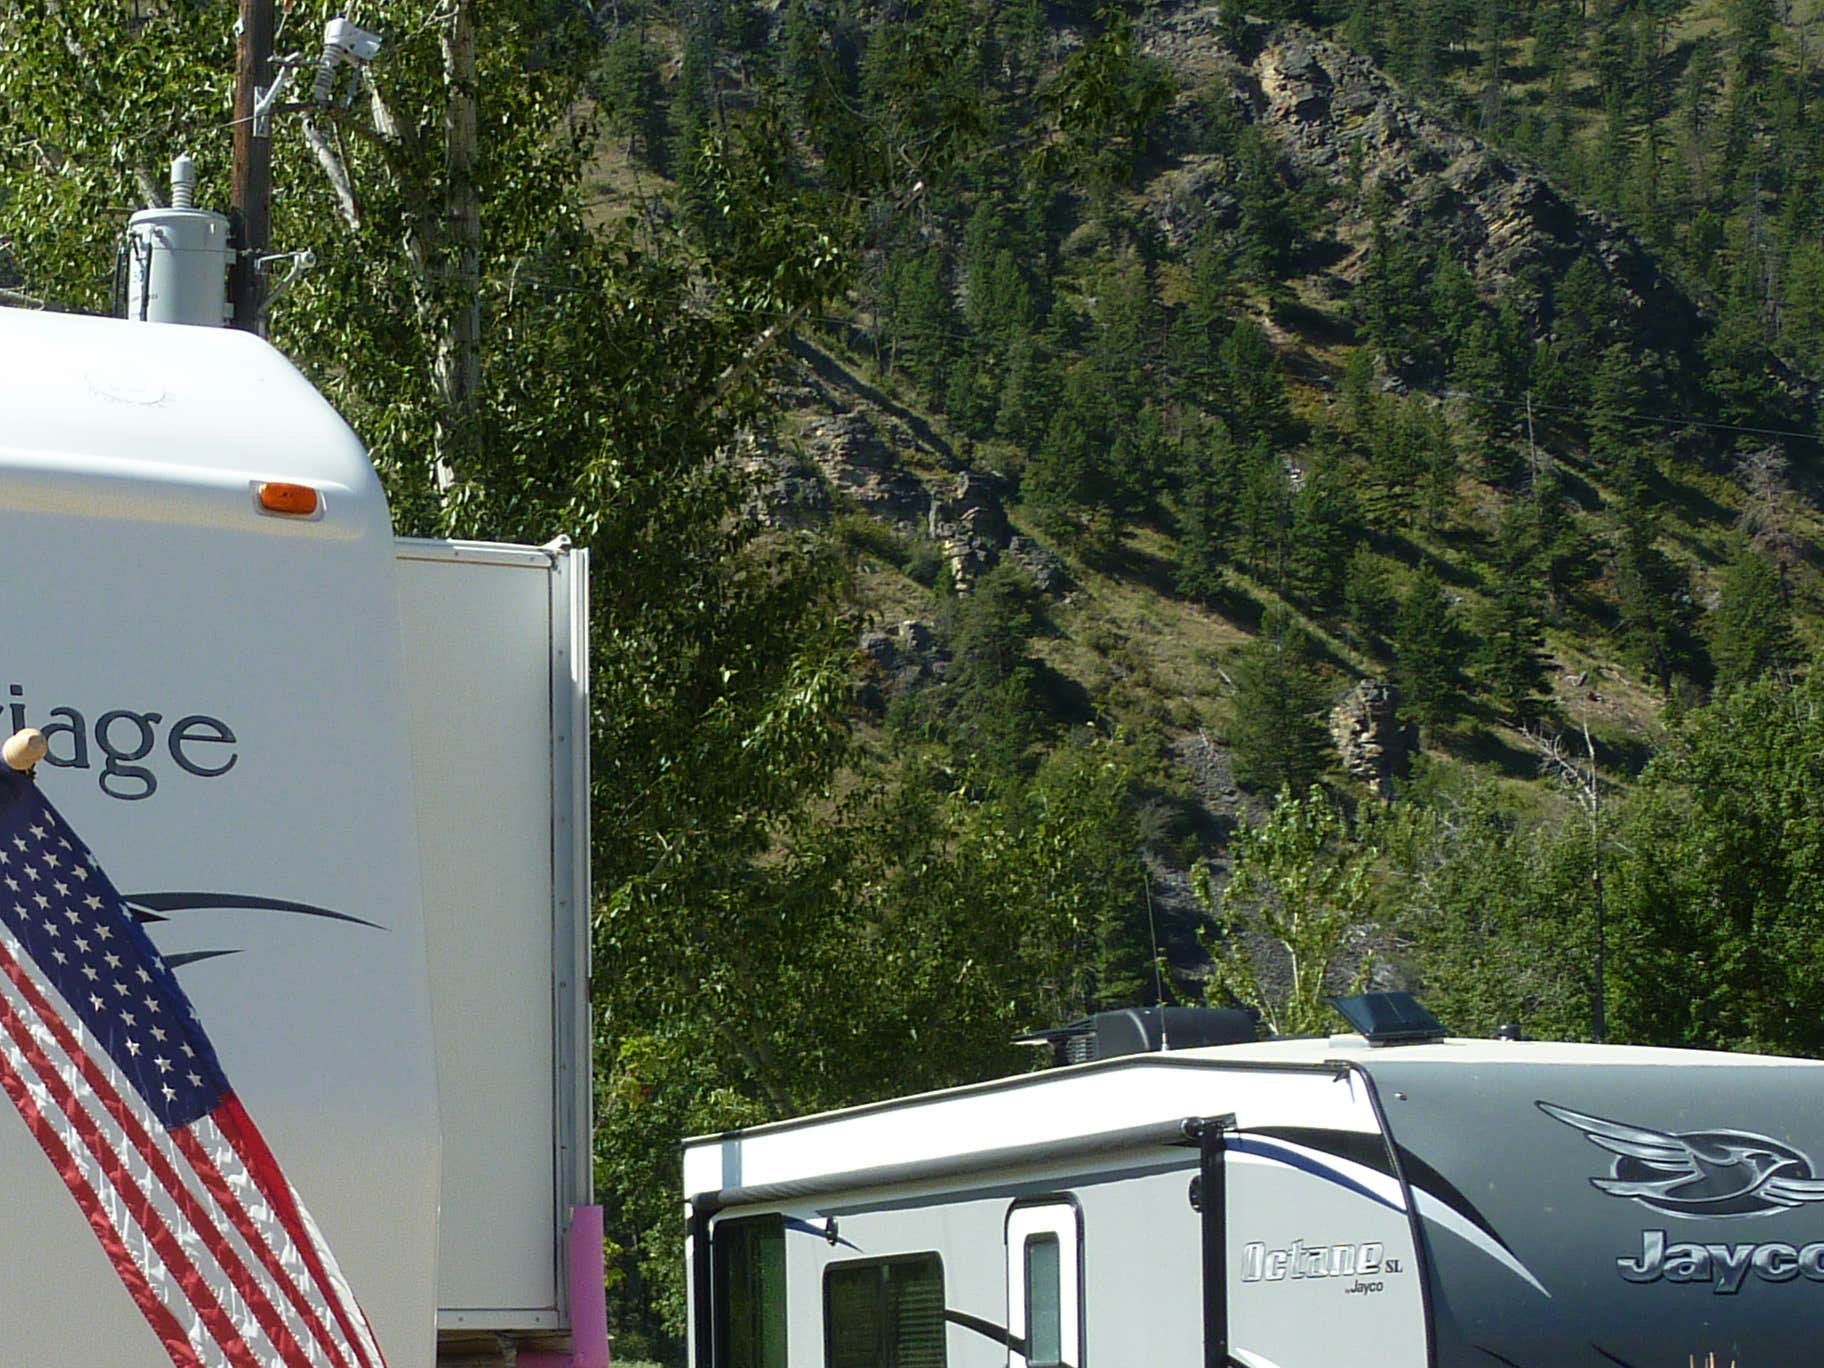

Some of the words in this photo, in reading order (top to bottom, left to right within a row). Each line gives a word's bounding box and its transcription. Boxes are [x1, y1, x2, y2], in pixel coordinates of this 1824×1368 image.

[1241, 1239, 1384, 1283] Octane
[1385, 1259, 1404, 1274] SL
[1350, 1279, 1384, 1296] Jayco
